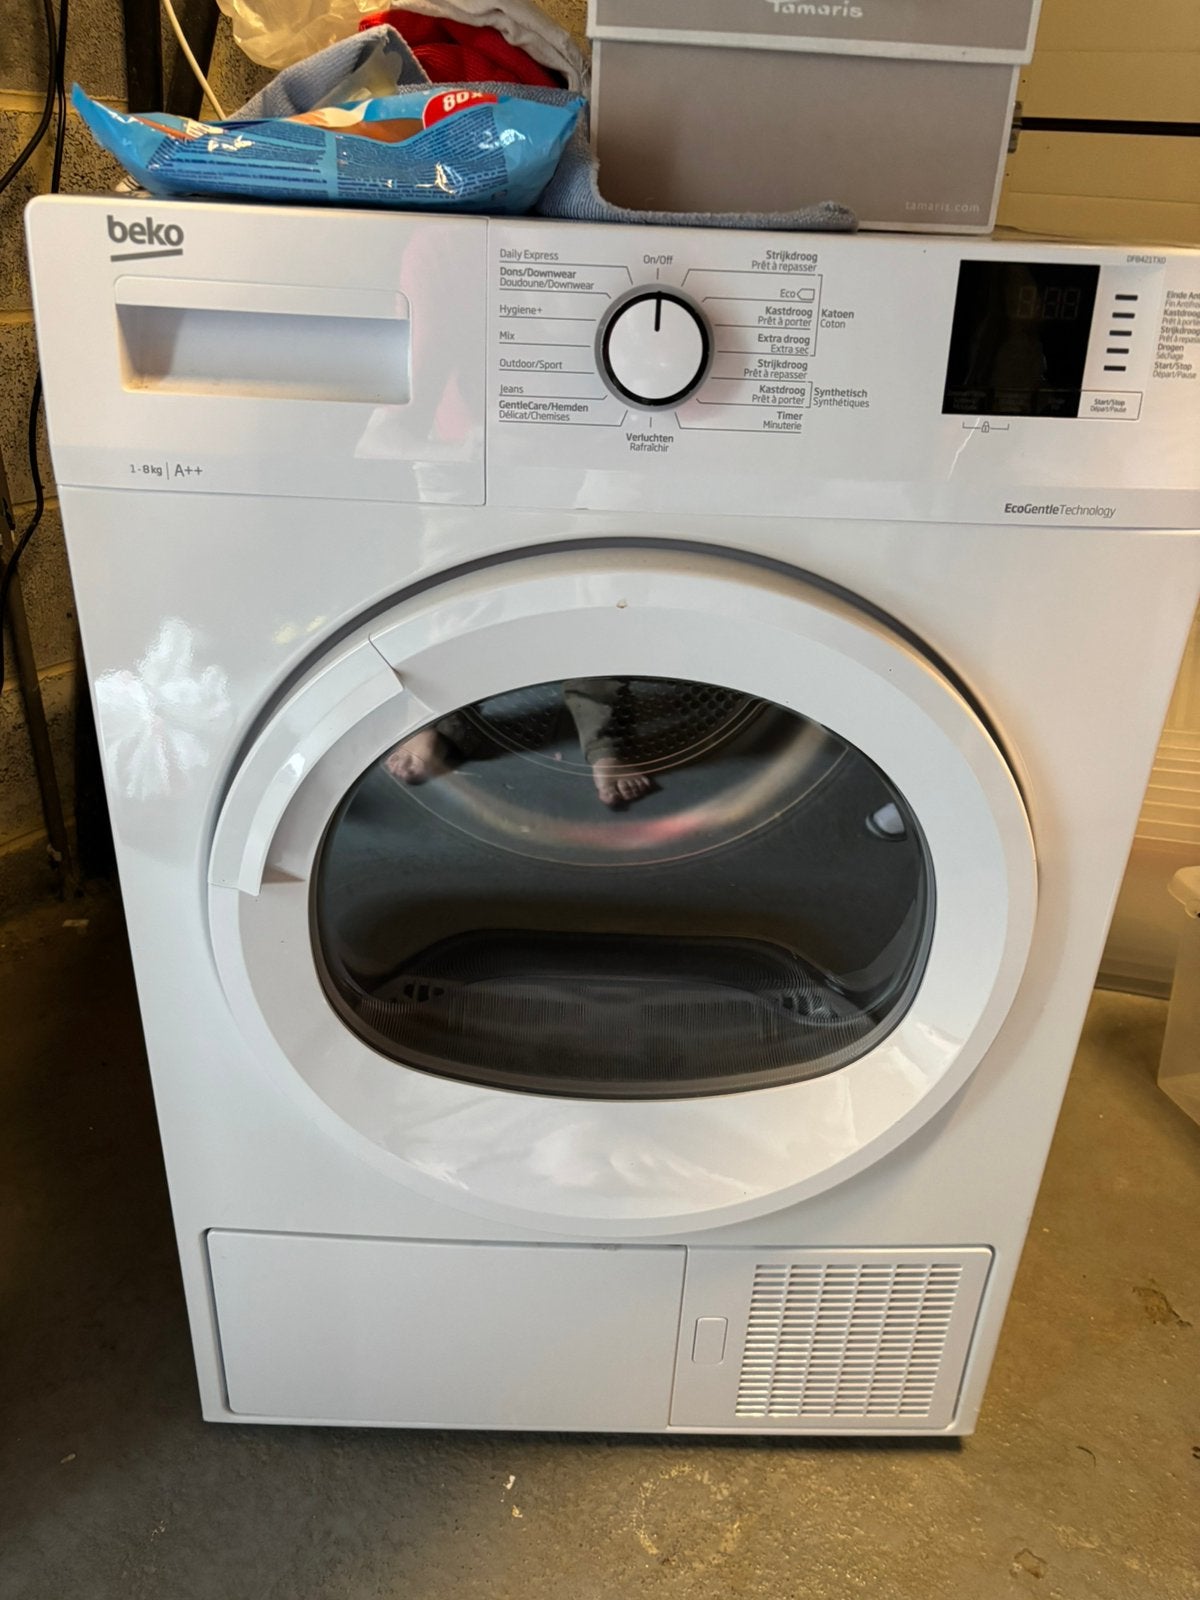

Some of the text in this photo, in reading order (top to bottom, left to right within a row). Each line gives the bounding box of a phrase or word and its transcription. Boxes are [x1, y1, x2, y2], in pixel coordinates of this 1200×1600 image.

[766, 0, 863, 18] Tamaris
[905, 201, 980, 213] tamaris.com
[106, 214, 184, 247] beko
[499, 249, 559, 261] Daily Express
[643, 255, 673, 265] On/Off
[766, 250, 818, 263] Strijkdroog
[751, 260, 817, 273] Prêt à repasser
[499, 267, 576, 279] Dons/Downwear
[499, 278, 595, 290] Doudoune/Downwear
[780, 288, 796, 298] Eco
[499, 304, 543, 317] Hygiene+
[765, 306, 813, 318] Kastdroog
[821, 309, 854, 319] Katoen
[757, 316, 812, 328] Prêt à porter
[820, 319, 846, 329] Coton
[499, 330, 515, 340] Mix
[758, 333, 810, 346] Extra droog
[770, 344, 809, 355] Extra sec
[499, 359, 563, 370] Outdoor/Sport
[758, 359, 808, 371] Strijkdroog
[743, 368, 807, 380] Prêt à repasser
[499, 384, 524, 394] Jeans
[759, 385, 806, 397] Kastdroog
[814, 387, 868, 399] Synthetisch
[499, 400, 589, 412] GentleCare/Hemden
[751, 394, 805, 406] Prêt à porter
[813, 397, 870, 408] Synthétiques
[499, 410, 570, 422] Délicat/Chemises
[777, 411, 803, 420] Timer
[763, 420, 802, 431] Minuterie
[626, 433, 674, 443] Verluchten
[630, 442, 669, 452] Rafraîchir
[174, 463, 203, 477] A++
